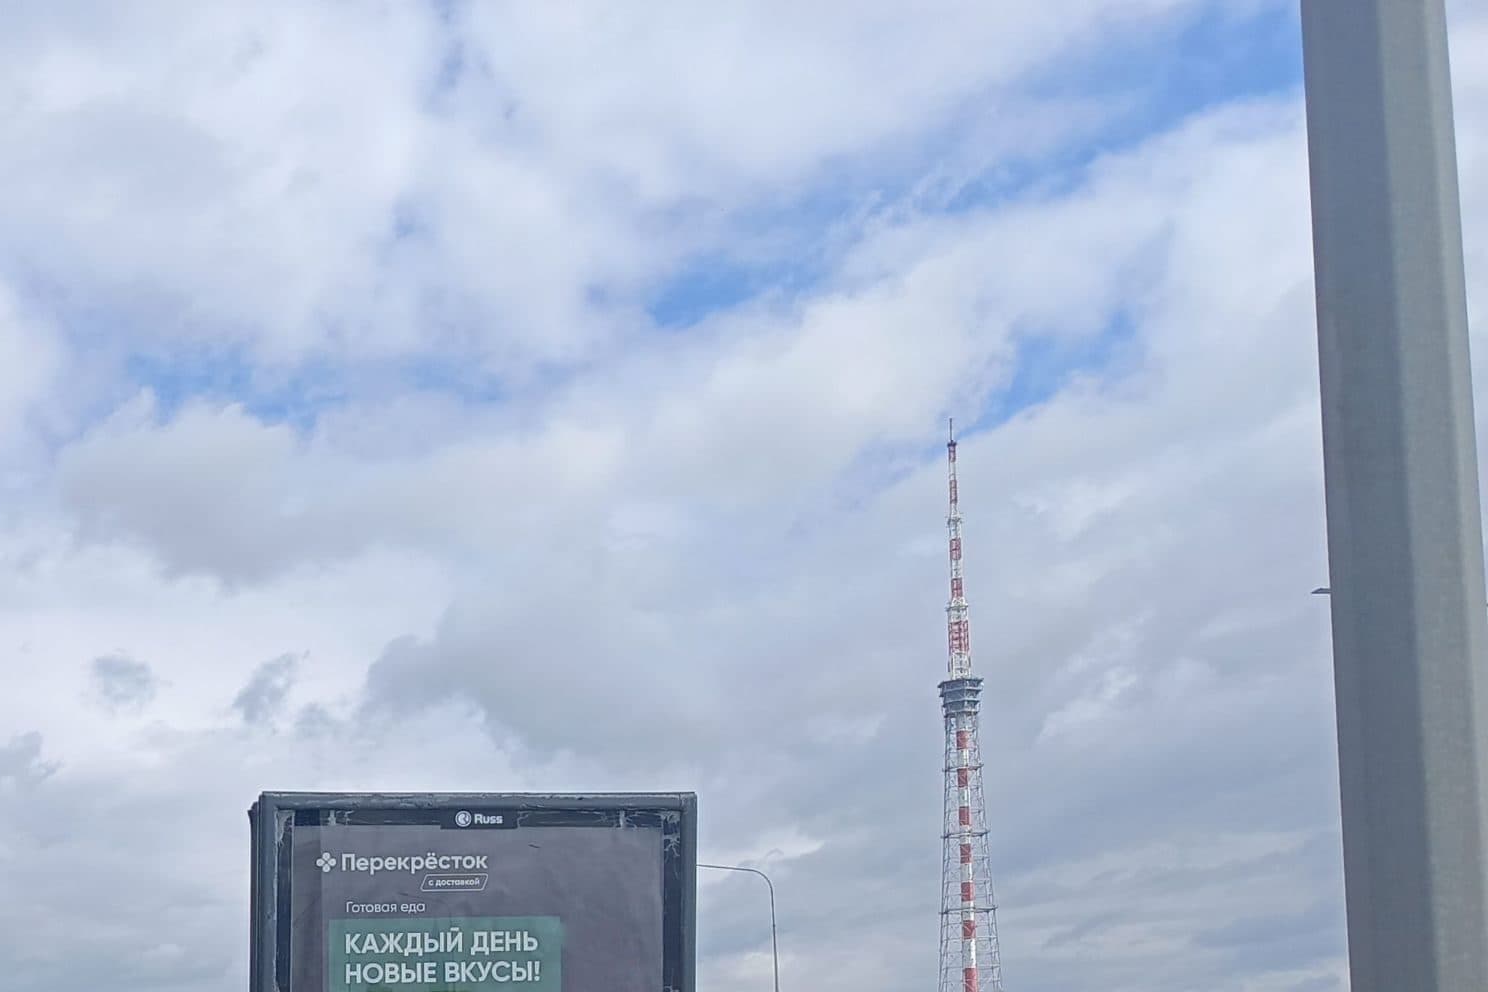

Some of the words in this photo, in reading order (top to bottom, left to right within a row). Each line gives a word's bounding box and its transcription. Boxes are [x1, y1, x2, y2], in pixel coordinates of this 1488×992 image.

[474, 814, 503, 824] Russ
[342, 852, 488, 875] Перекрёсток
[435, 878, 480, 887] доставкой
[346, 902, 397, 913] Готовая
[401, 903, 425, 914] еда
[345, 927, 462, 956] КАЖДЫЙ
[470, 931, 538, 955] ДЕНЬ
[345, 962, 436, 984] НОВЫЕ
[444, 961, 541, 983] ВКУСЫ!
